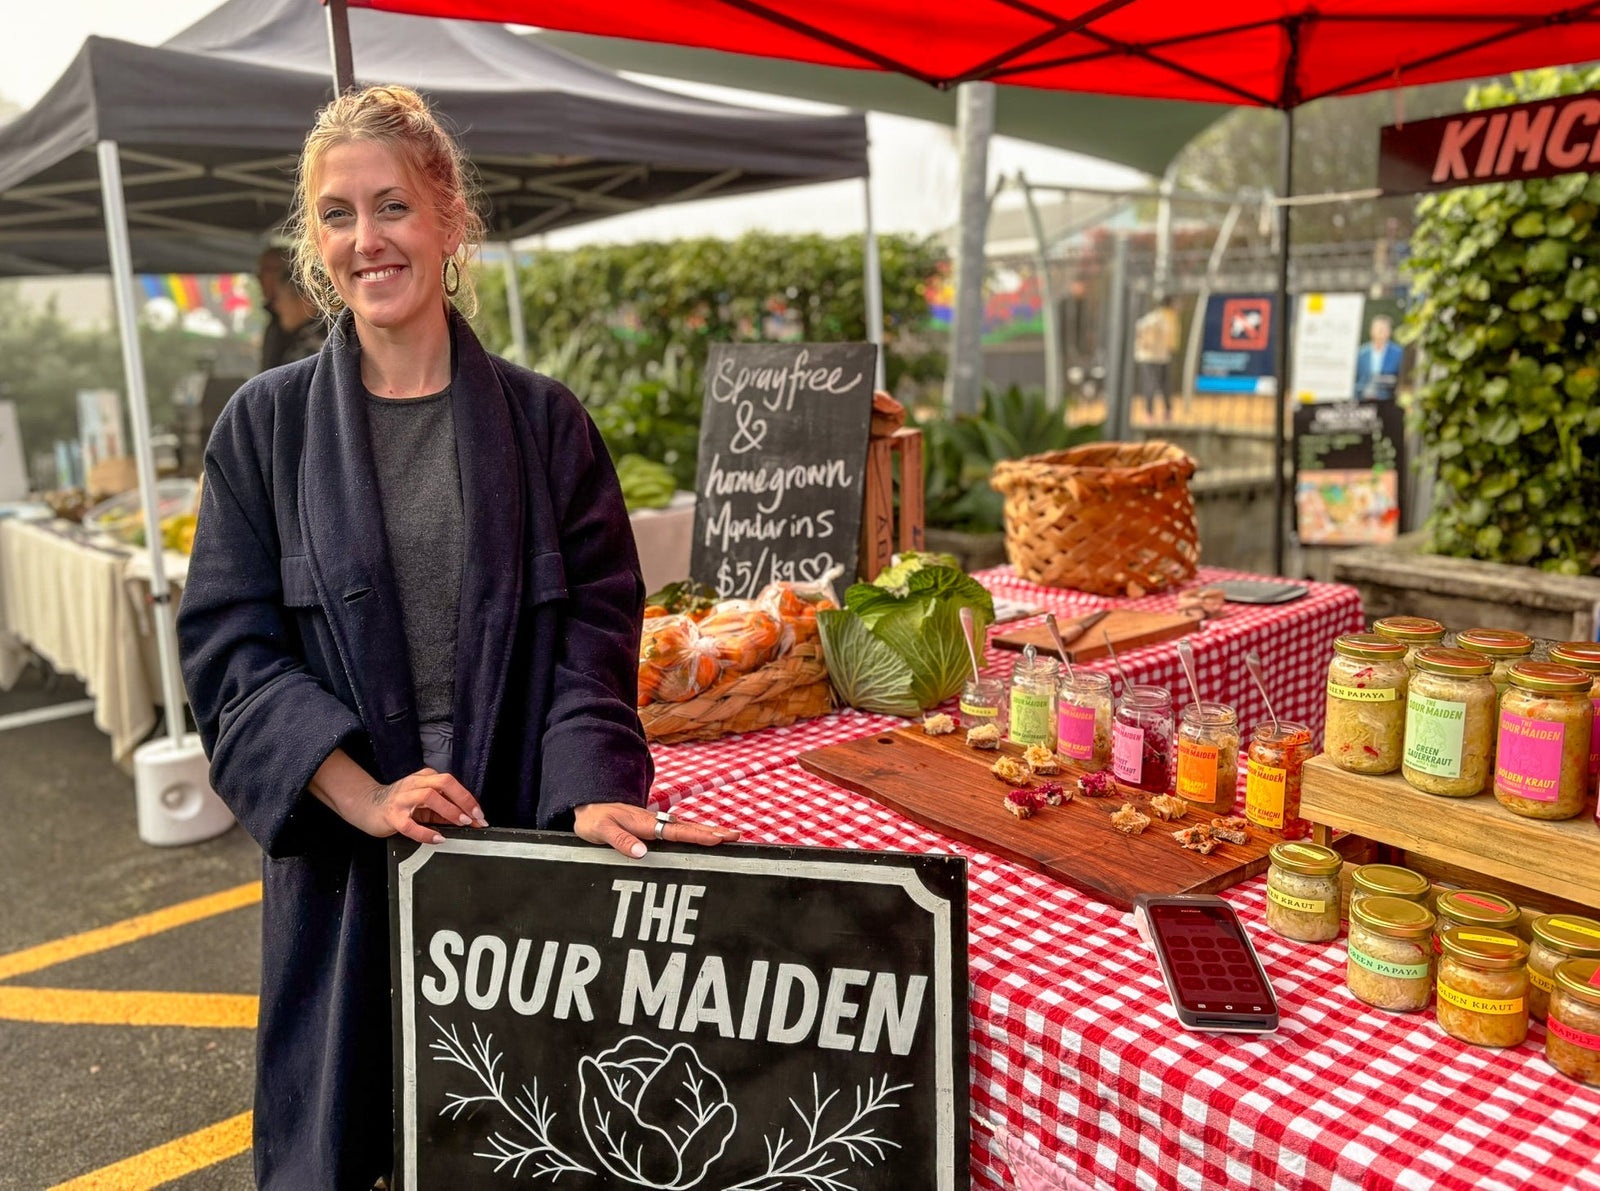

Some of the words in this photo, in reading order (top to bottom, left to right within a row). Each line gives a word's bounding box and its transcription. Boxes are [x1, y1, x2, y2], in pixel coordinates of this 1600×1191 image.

[1432, 97, 1600, 183] KIMC
[729, 400, 768, 455] &
[704, 501, 836, 553] Mandarins
[1347, 689, 1385, 699] PAPAYA
[1409, 699, 1425, 713] SOUR
[1425, 706, 1463, 720] MAIDEN
[1426, 699, 1437, 707] THE
[1502, 719, 1520, 734] SOUR
[1520, 726, 1561, 741] MAIDEN
[1521, 720, 1533, 728] THE
[1190, 750, 1217, 760] MAIDEN
[1416, 744, 1440, 756] GREEN
[1408, 748, 1453, 767] SAUERKRAUT
[1257, 772, 1284, 783] MAIDEN
[1524, 777, 1557, 789] KRAUT
[1257, 808, 1281, 819] KIMCHI
[1281, 895, 1315, 910] KRAUT
[611, 879, 706, 945] THE
[1377, 963, 1419, 976] PAPAYA
[421, 929, 602, 1022] SOUR
[618, 949, 928, 1056] MAIDEN
[1472, 998, 1514, 1012] KRAUT
